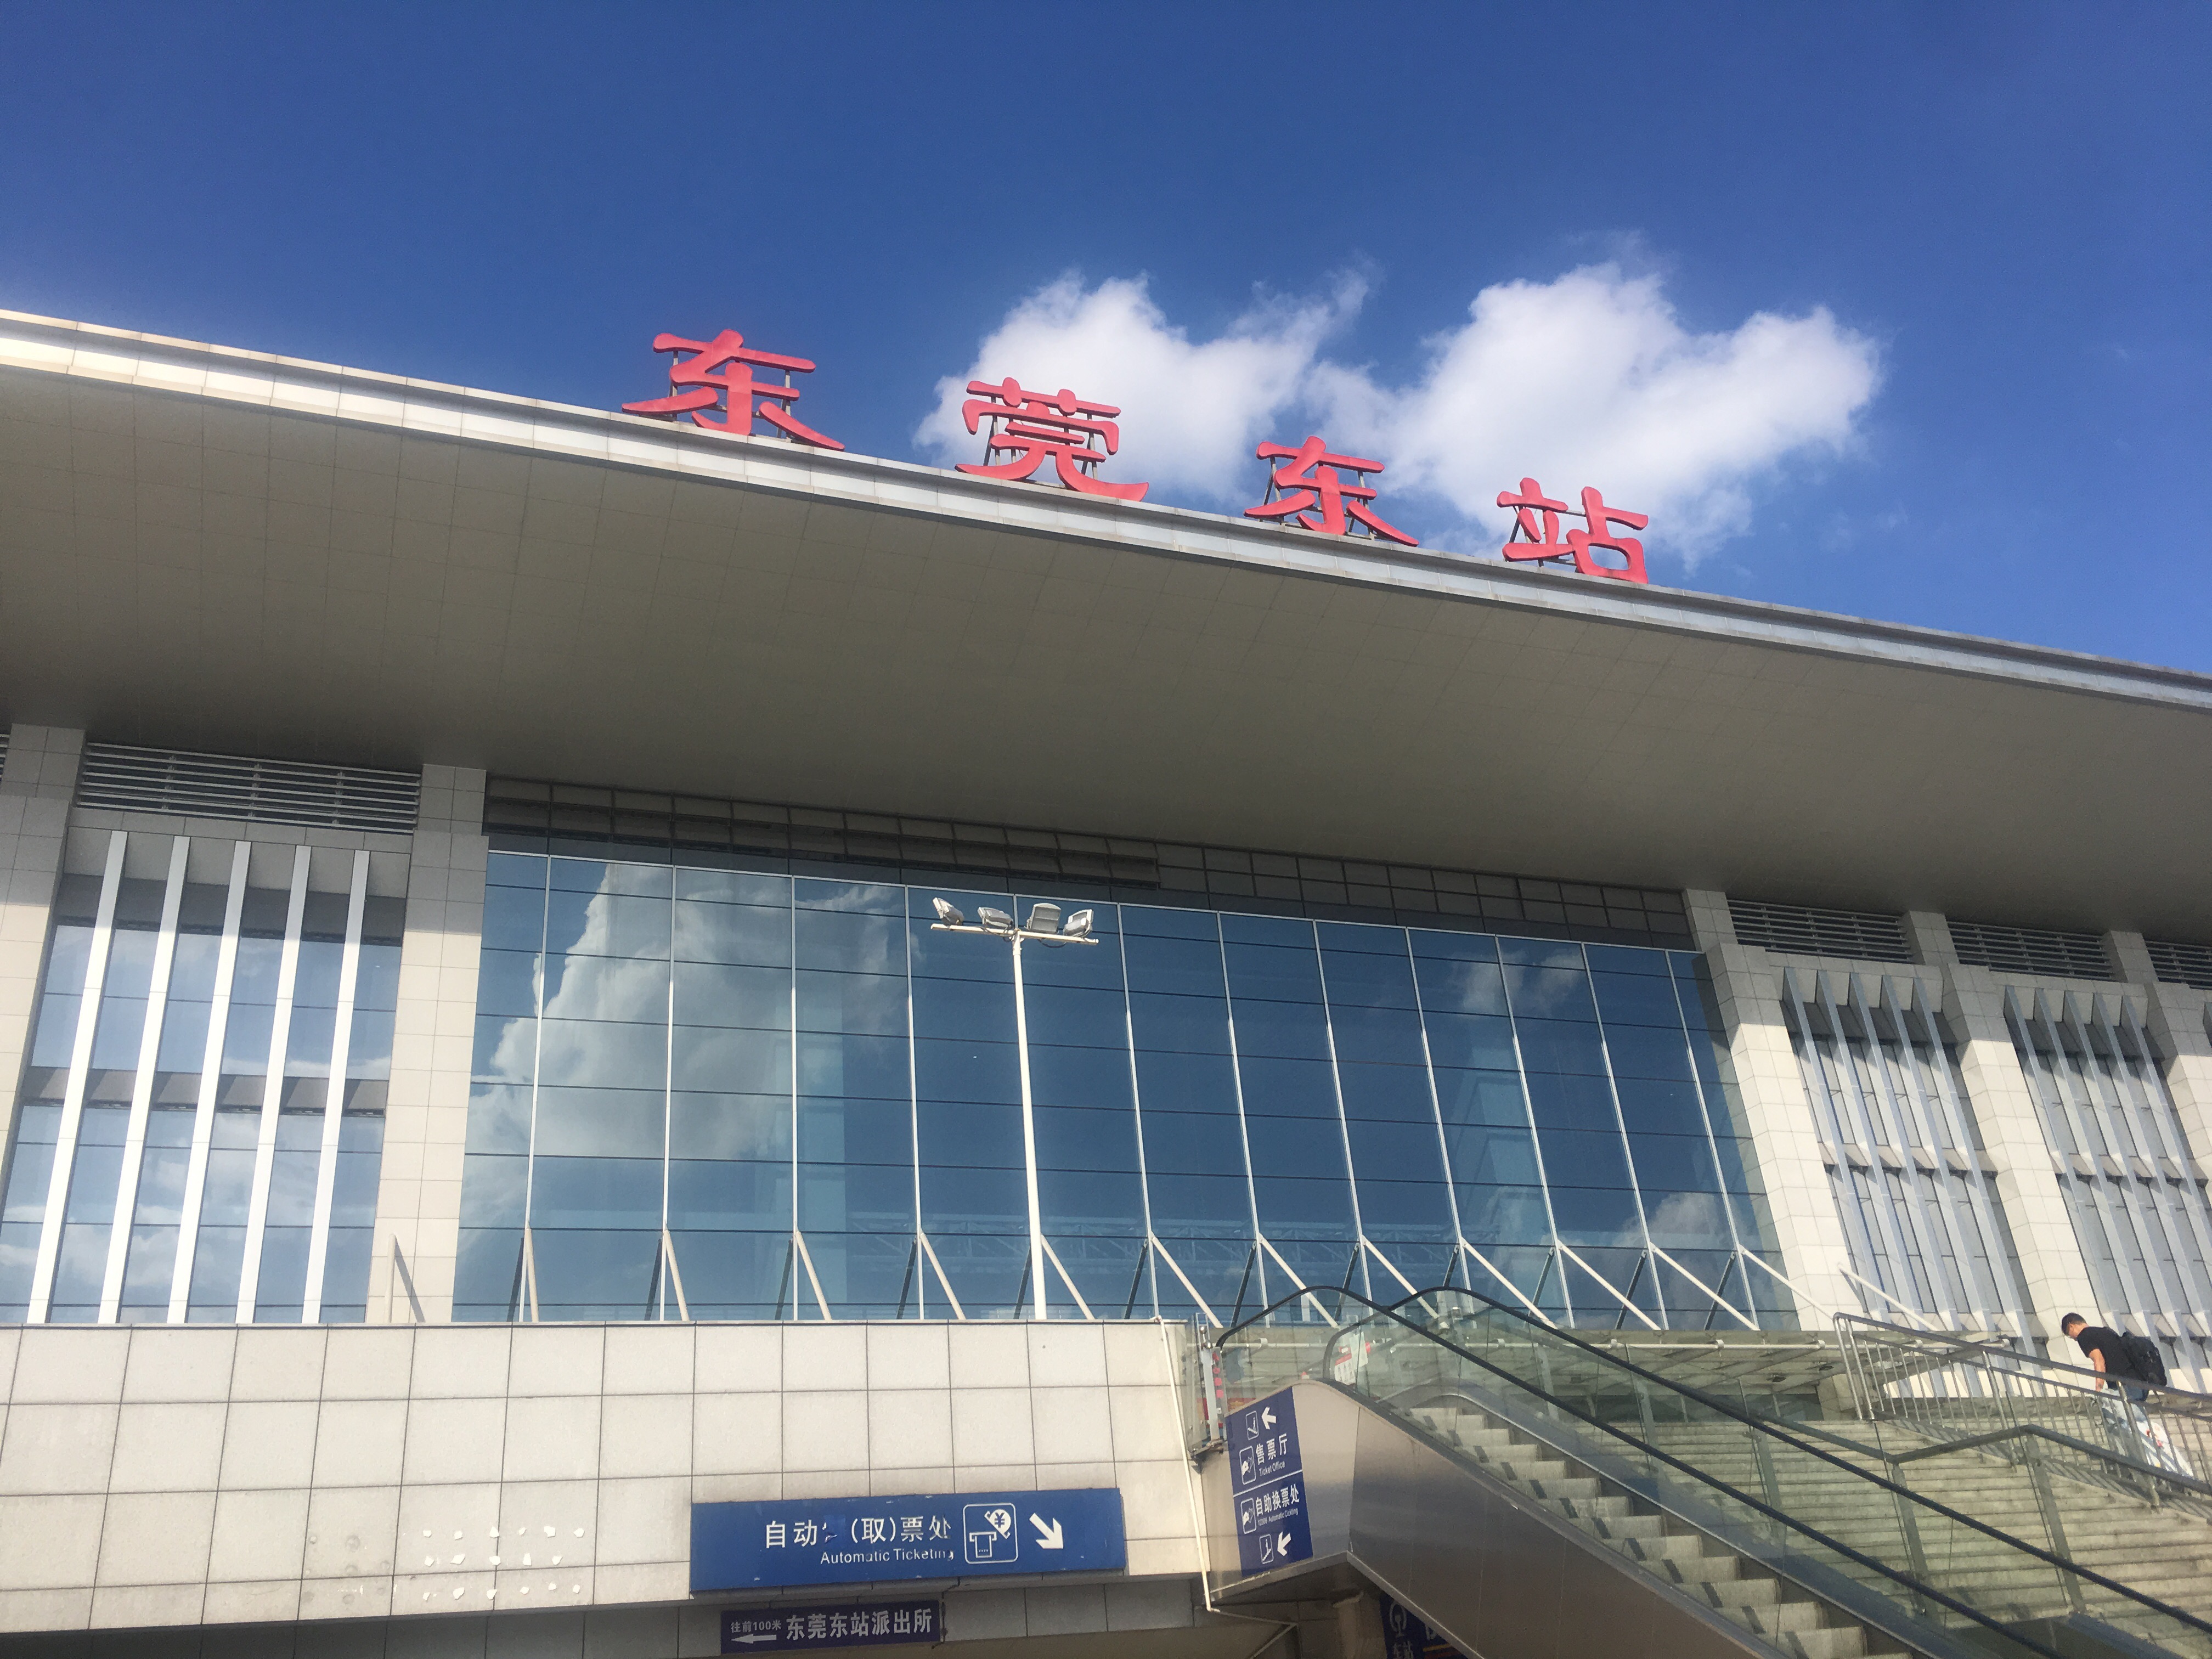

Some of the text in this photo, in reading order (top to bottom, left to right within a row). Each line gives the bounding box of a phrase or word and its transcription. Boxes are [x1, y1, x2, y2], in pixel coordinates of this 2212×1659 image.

[622, 329, 1649, 584] 东莞东站
[1256, 1433, 1288, 1465] 售票厅
[1259, 1461, 1285, 1476] Ticket Office
[1255, 1483, 1300, 1516] 自助换票处
[765, 1515, 951, 1549] 自动（取）票处
[820, 1550, 890, 1564] Automatic
[731, 1608, 932, 1640] 往前100米 东莞东站派出所
